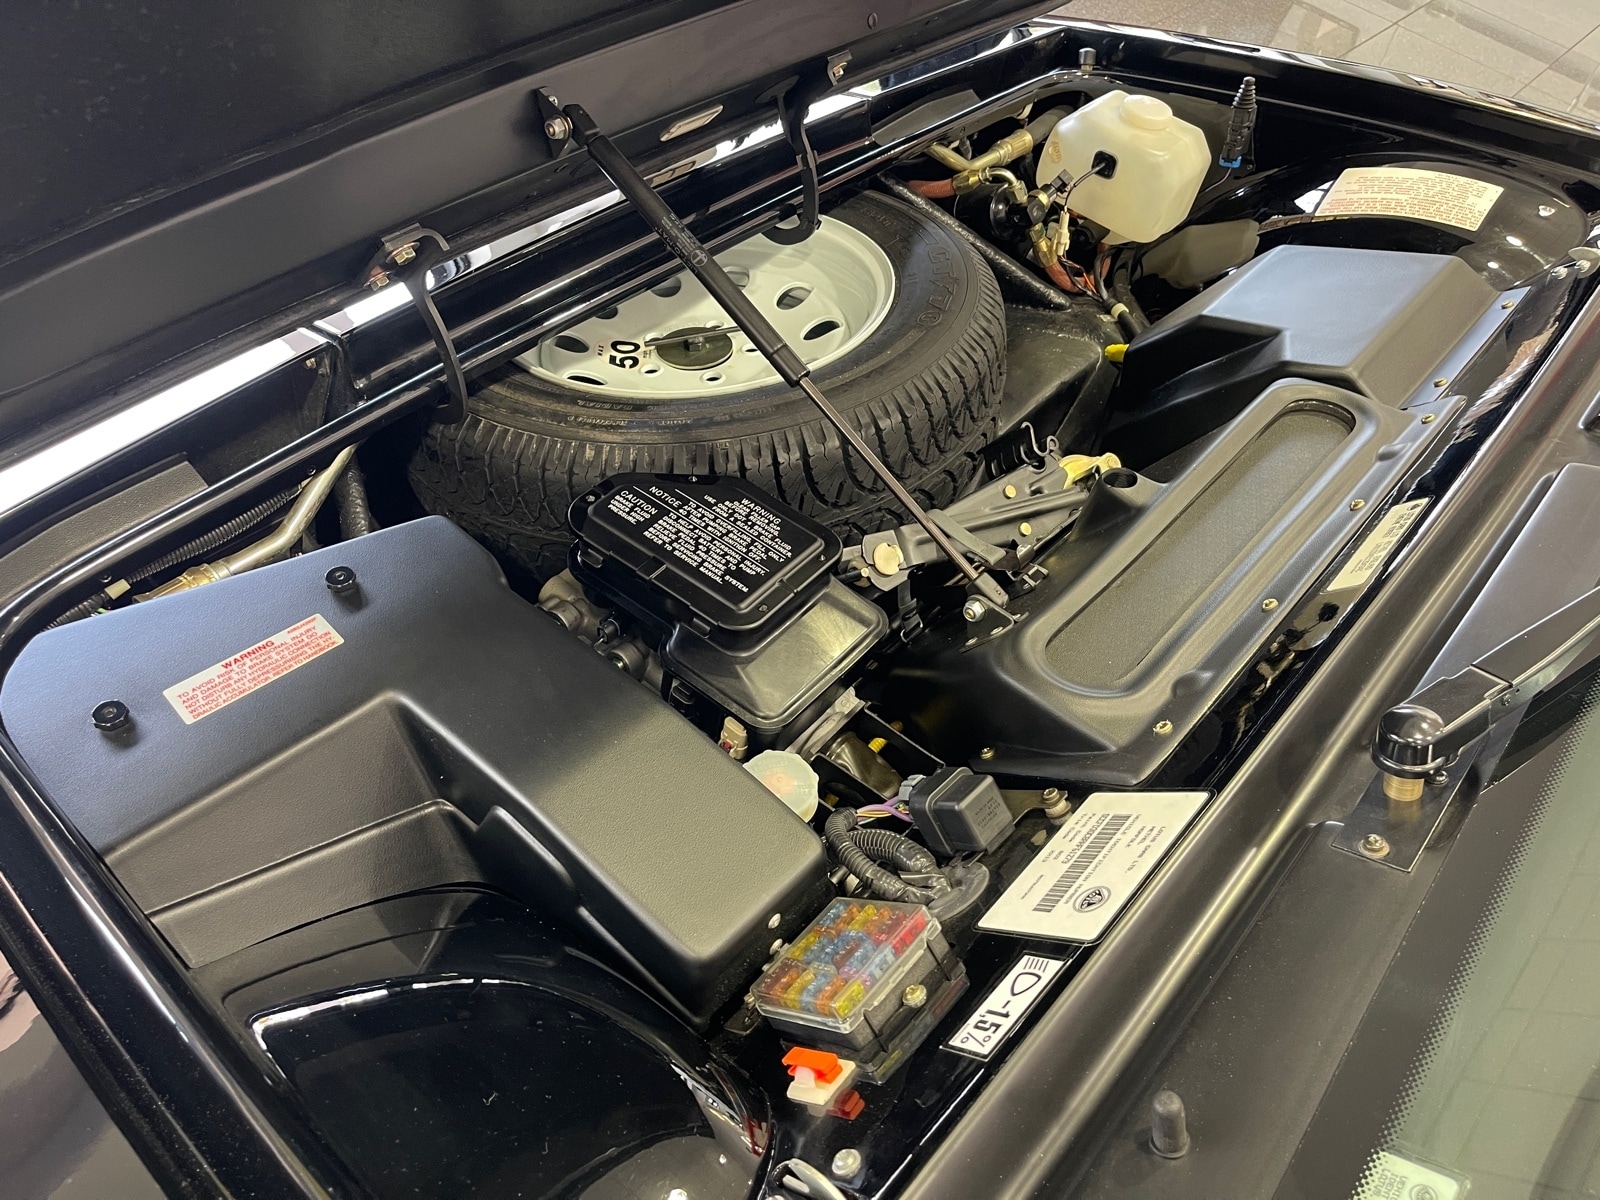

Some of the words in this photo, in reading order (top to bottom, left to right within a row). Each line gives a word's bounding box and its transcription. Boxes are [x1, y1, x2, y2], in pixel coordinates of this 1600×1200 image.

[608, 340, 641, 369] 50
[609, 499, 629, 512] UNDER
[629, 511, 645, 521] HIGH
[613, 495, 633, 507] BRAKE
[633, 507, 651, 518] FLUID
[619, 489, 658, 514] CAUTION
[648, 486, 681, 507] NOTICE
[723, 500, 747, 515] BEFORE
[733, 500, 750, 512] CLEAN
[750, 511, 768, 523] FILLER
[768, 523, 780, 531] CAP
[740, 498, 781, 524] WARNING
[657, 519, 677, 532] BRAKE
[677, 532, 697, 545] PEDAL
[707, 551, 726, 563] TIMES
[677, 518, 693, 529] HELP
[693, 529, 712, 540] AVOID
[712, 540, 743, 560] PERSONAL
[682, 505, 701, 517] AFTER
[701, 517, 727, 533] PUMPING
[727, 533, 748, 546] BRAKE
[748, 546, 768, 559] PEDAL
[687, 515, 705, 526] TIMES
[706, 526, 721, 536] WITH
[721, 535, 747, 552] IGNITION
[697, 507, 714, 519] AVOID
[752, 542, 767, 551] FILL
[767, 551, 784, 562] ONLY
[703, 495, 716, 503] USE
[716, 503, 732, 513] ONLY
[733, 513, 746, 521] DOT
[752, 525, 772, 537] BRAKE
[774, 538, 791, 550] FLUID
[711, 506, 728, 517] FROM
[735, 521, 758, 535] SEALED
[642, 531, 663, 544] REFER
[672, 550, 698, 567] SERVICE
[647, 527, 671, 542] BEFORE
[671, 542, 702, 562] SERVICING
[702, 561, 724, 575] BRAKE
[723, 575, 750, 592] SYSTEM
[652, 523, 677, 539] RELIEVE
[677, 539, 695, 550] FLUID
[695, 550, 727, 571] PRESSURE
[661, 516, 697, 538] DISCONNECT
[697, 538, 723, 555] BATTERY
[724, 554, 738, 564] AND
[738, 563, 756, 575] PUMP
[177, 691, 189, 699] TO
[190, 678, 216, 692] AVOID
[216, 668, 235, 679] RISK
[236, 661, 248, 669] OF
[249, 640, 289, 662] PERSONAL
[290, 625, 317, 641] INJURY
[180, 693, 199, 704] AND
[199, 675, 234, 694] DAMAGE
[235, 668, 246, 676] TO
[247, 654, 273, 669] BRAKE
[274, 638, 305, 655] SYSTEM
[305, 631, 318, 639] DO
[184, 699, 200, 709] NOT
[201, 682, 233, 700] DISTURB
[232, 674, 248, 684] ANY
[247, 654, 287, 676] HYDRAULIC
[287, 631, 331, 655] CONNECTION
[221, 640, 275, 669] WARNING
[188, 694, 223, 714] WITHOUT
[223, 682, 246, 695] FULLY
[247, 650, 307, 683] DEPRESSURISING
[308, 642, 322, 651] THE
[192, 701, 222, 719] DRAULIC
[271, 663, 295, 677] REFER
